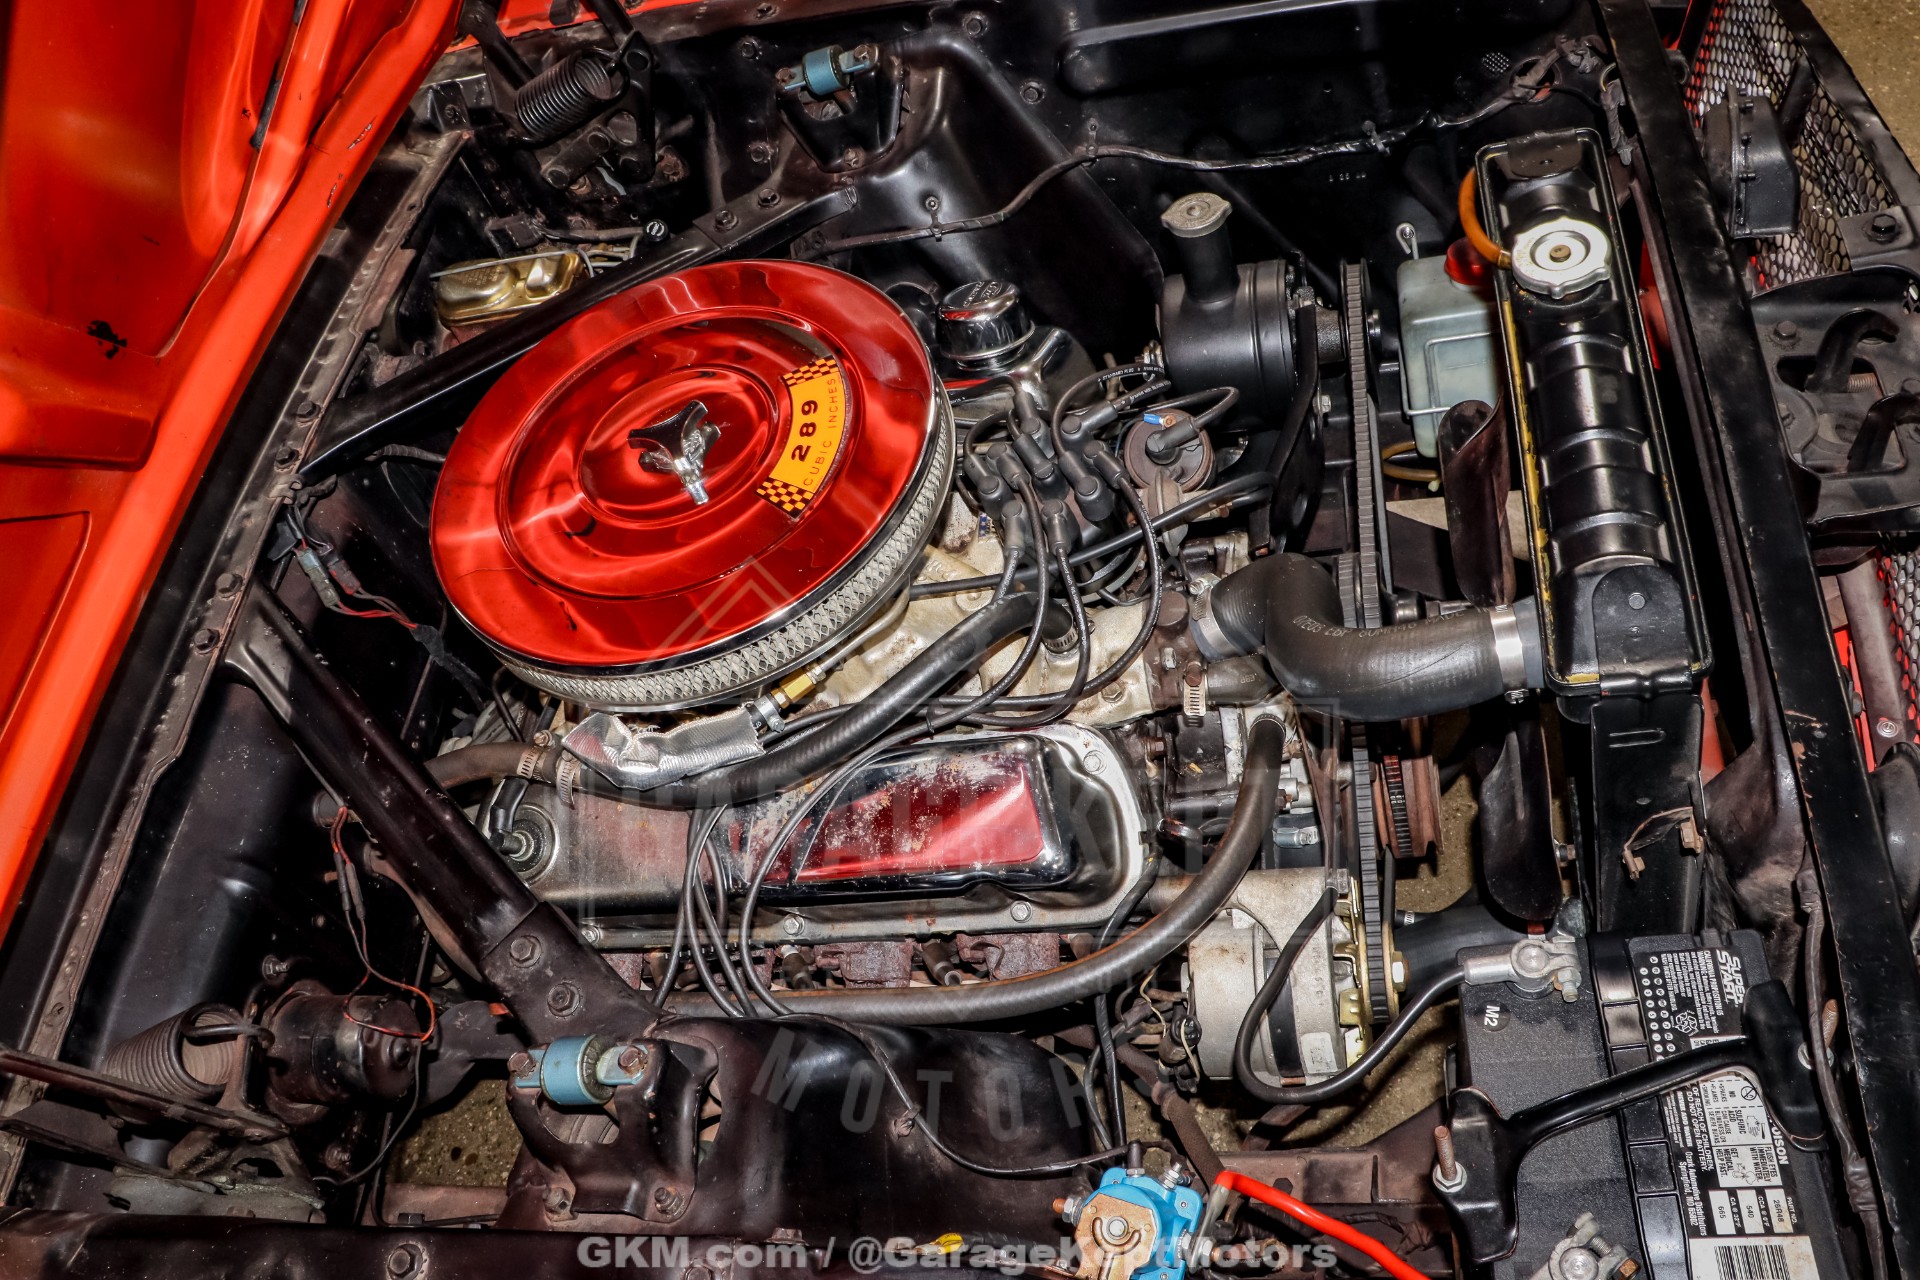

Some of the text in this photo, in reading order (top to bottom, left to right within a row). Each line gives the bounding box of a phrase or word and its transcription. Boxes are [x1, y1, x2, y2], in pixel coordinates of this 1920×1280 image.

[790, 398, 819, 461] 289
[803, 377, 838, 487] CUBIC INCHES
[1716, 949, 1739, 1004] START
[1727, 956, 1746, 1003] SUPER
[1483, 1003, 1503, 1026] M2
[1677, 1090, 1685, 1110] NEVER
[1683, 1126, 1692, 1146] WATER
[1686, 1091, 1708, 1171] DO NOT OPEN BATTERY.
[1691, 1087, 1714, 1170] OF REACH OF CHILDREN.
[1727, 1109, 1736, 1122] ACID
[1734, 1109, 1746, 1134] SULFURIC
[1723, 1148, 1734, 1170] MEDICAL
[1730, 1147, 1738, 1157] GET
[1770, 1121, 1788, 1164] OISON
[1678, 1161, 1693, 1194] Springfield,
[1715, 1148, 1728, 1176] HELP FAST.
[1749, 1146, 1763, 1182] WITH WATER.
[1757, 1146, 1771, 1182] IMMEDIATELY
[1764, 1146, 1777, 1177] FLUSH EYES
[1684, 1151, 1708, 1235] Ozark Automotive Distributors
[1786, 1196, 1794, 1213] PART
[1717, 1206, 1726, 1218] 665
[1745, 1205, 1754, 1218] 540
